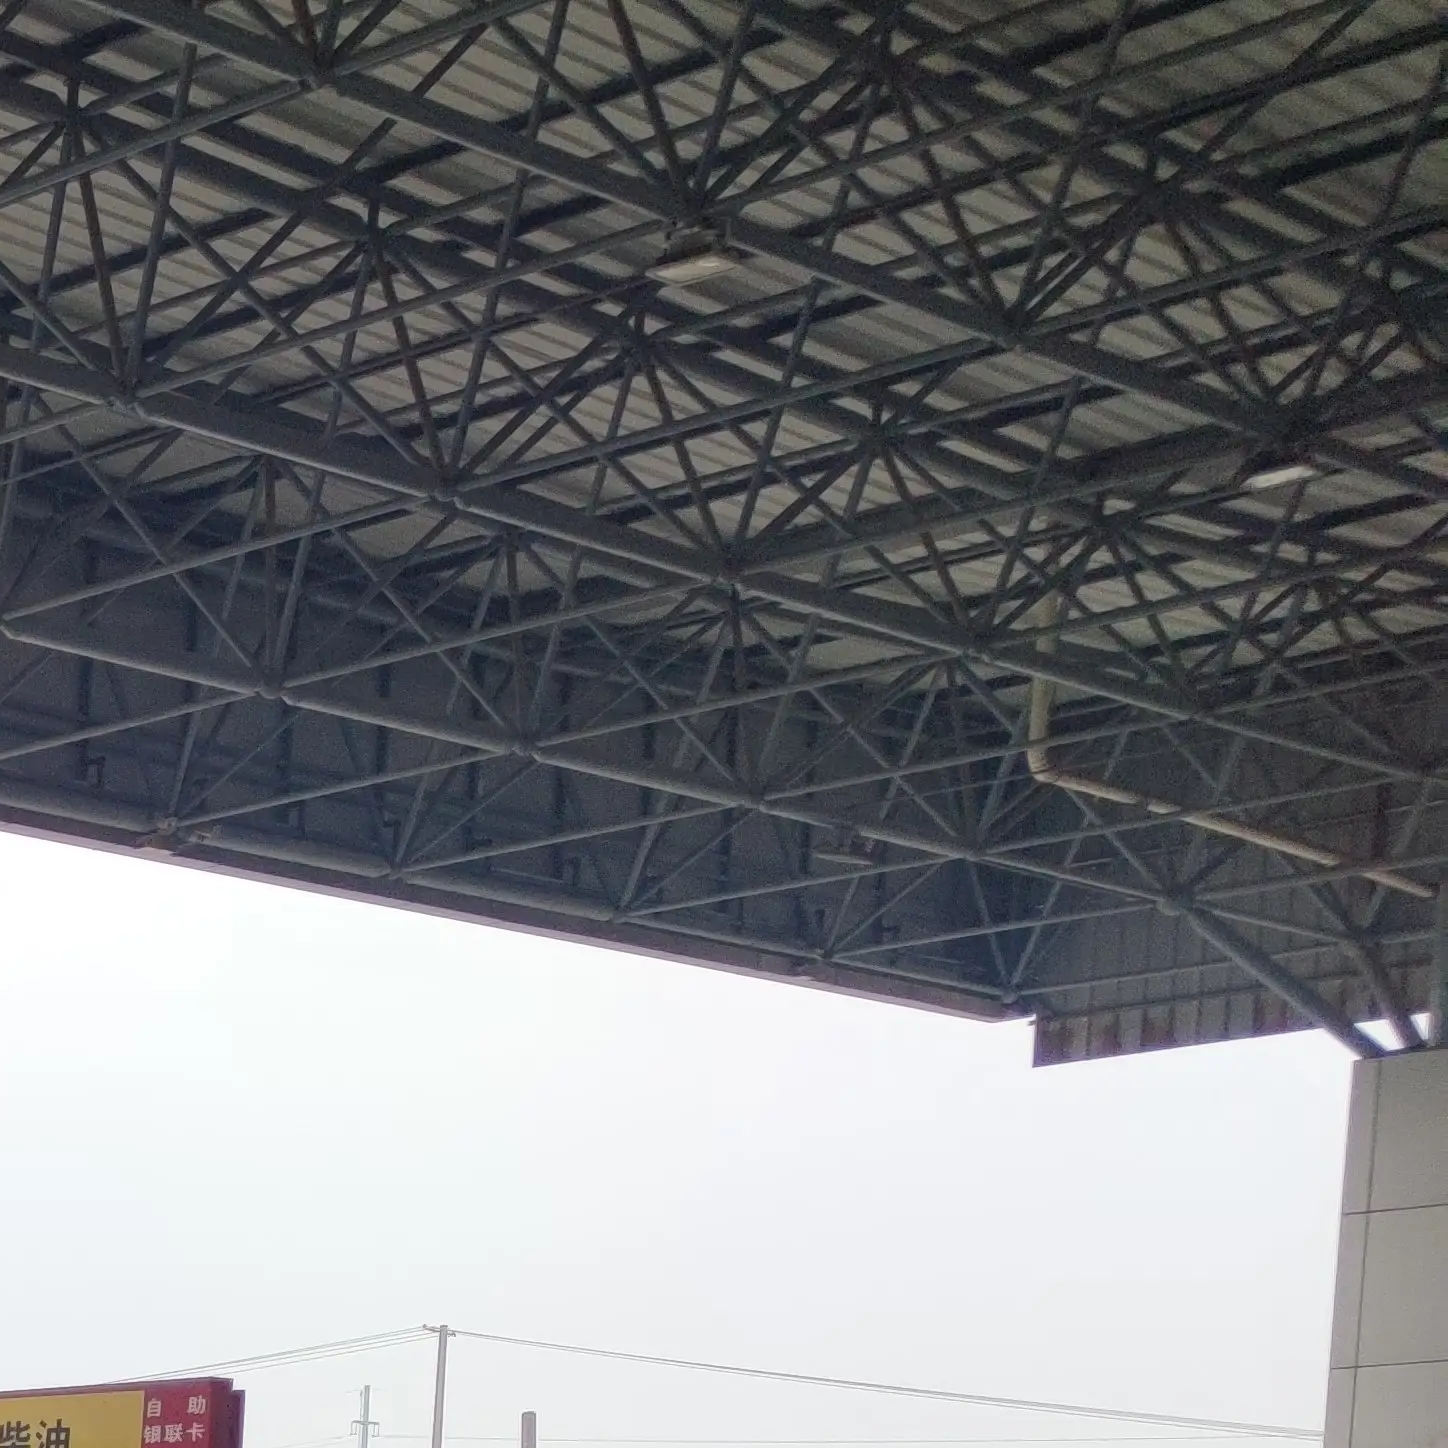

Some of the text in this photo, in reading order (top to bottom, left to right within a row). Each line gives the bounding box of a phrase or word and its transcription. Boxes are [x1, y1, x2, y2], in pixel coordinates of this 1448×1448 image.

[146, 1396, 205, 1418] 自助
[143, 1423, 205, 1444] 银联卡
